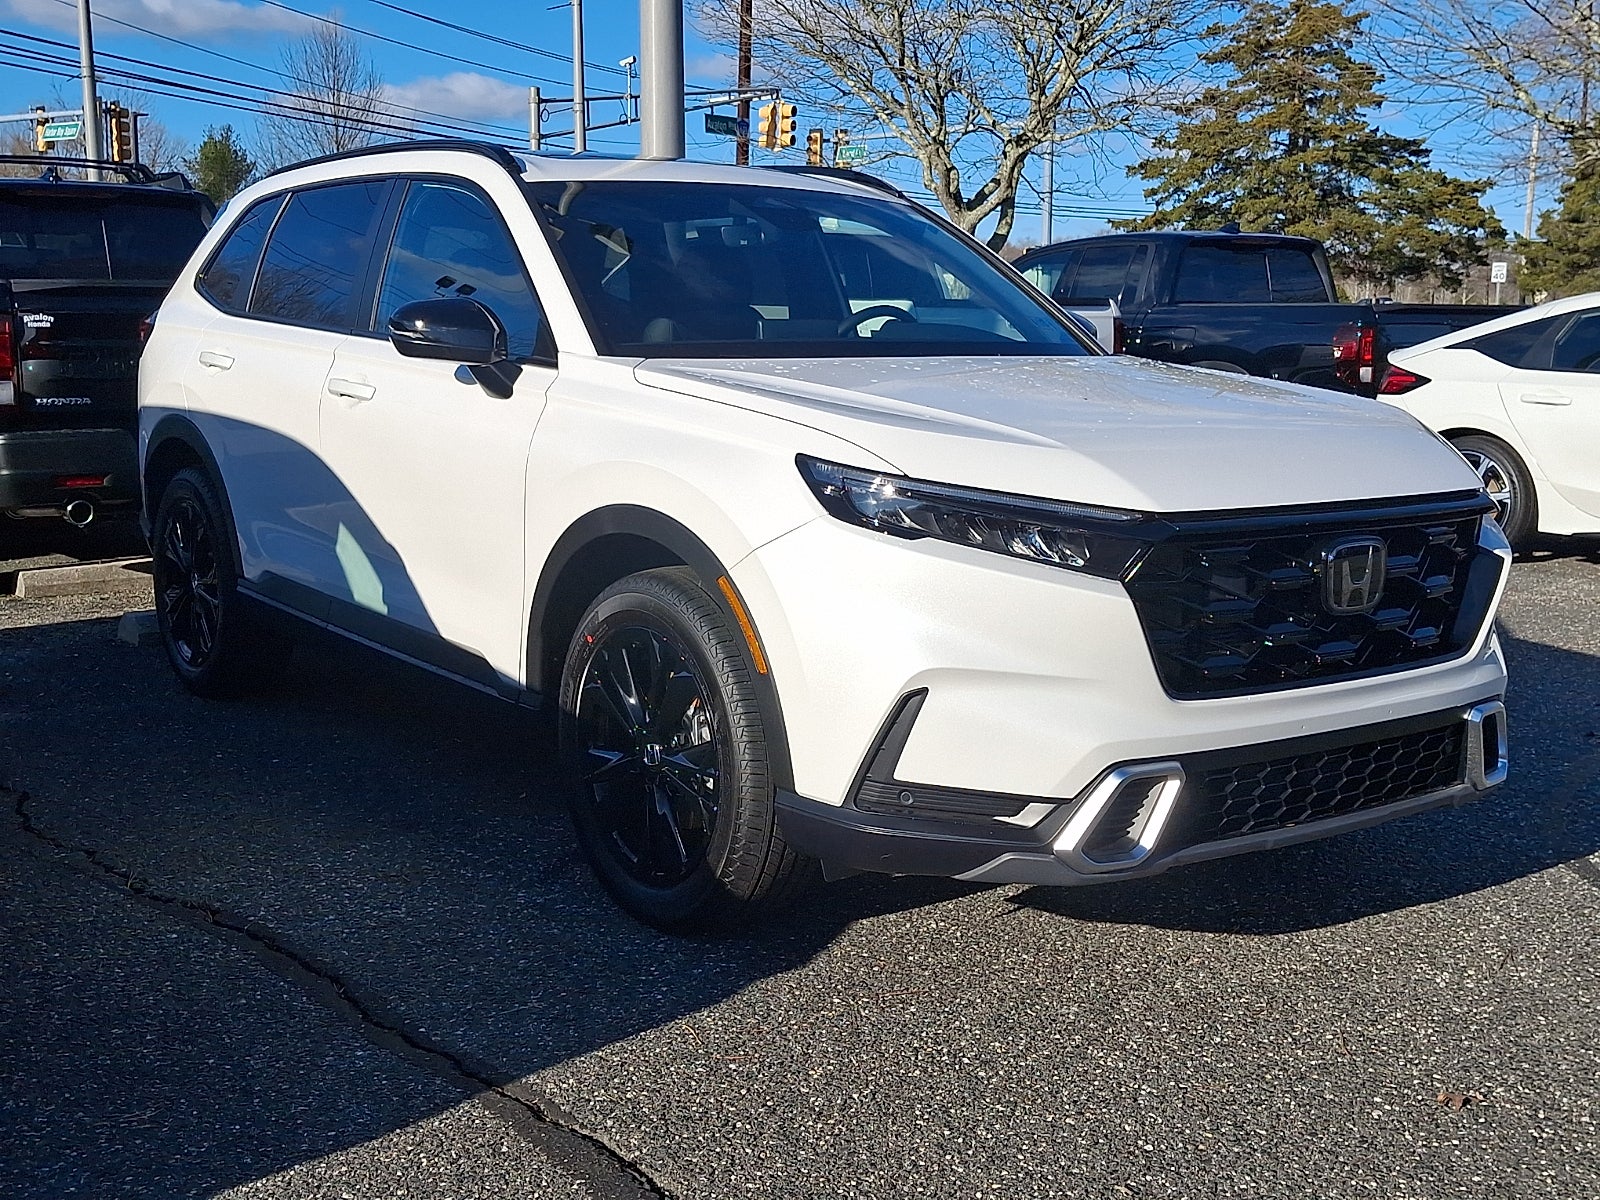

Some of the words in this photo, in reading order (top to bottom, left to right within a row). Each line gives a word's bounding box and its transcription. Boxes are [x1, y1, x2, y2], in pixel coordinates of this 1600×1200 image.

[1493, 272, 1505, 280] 40
[23, 313, 54, 323] Avalon
[35, 397, 92, 406] HONDA
